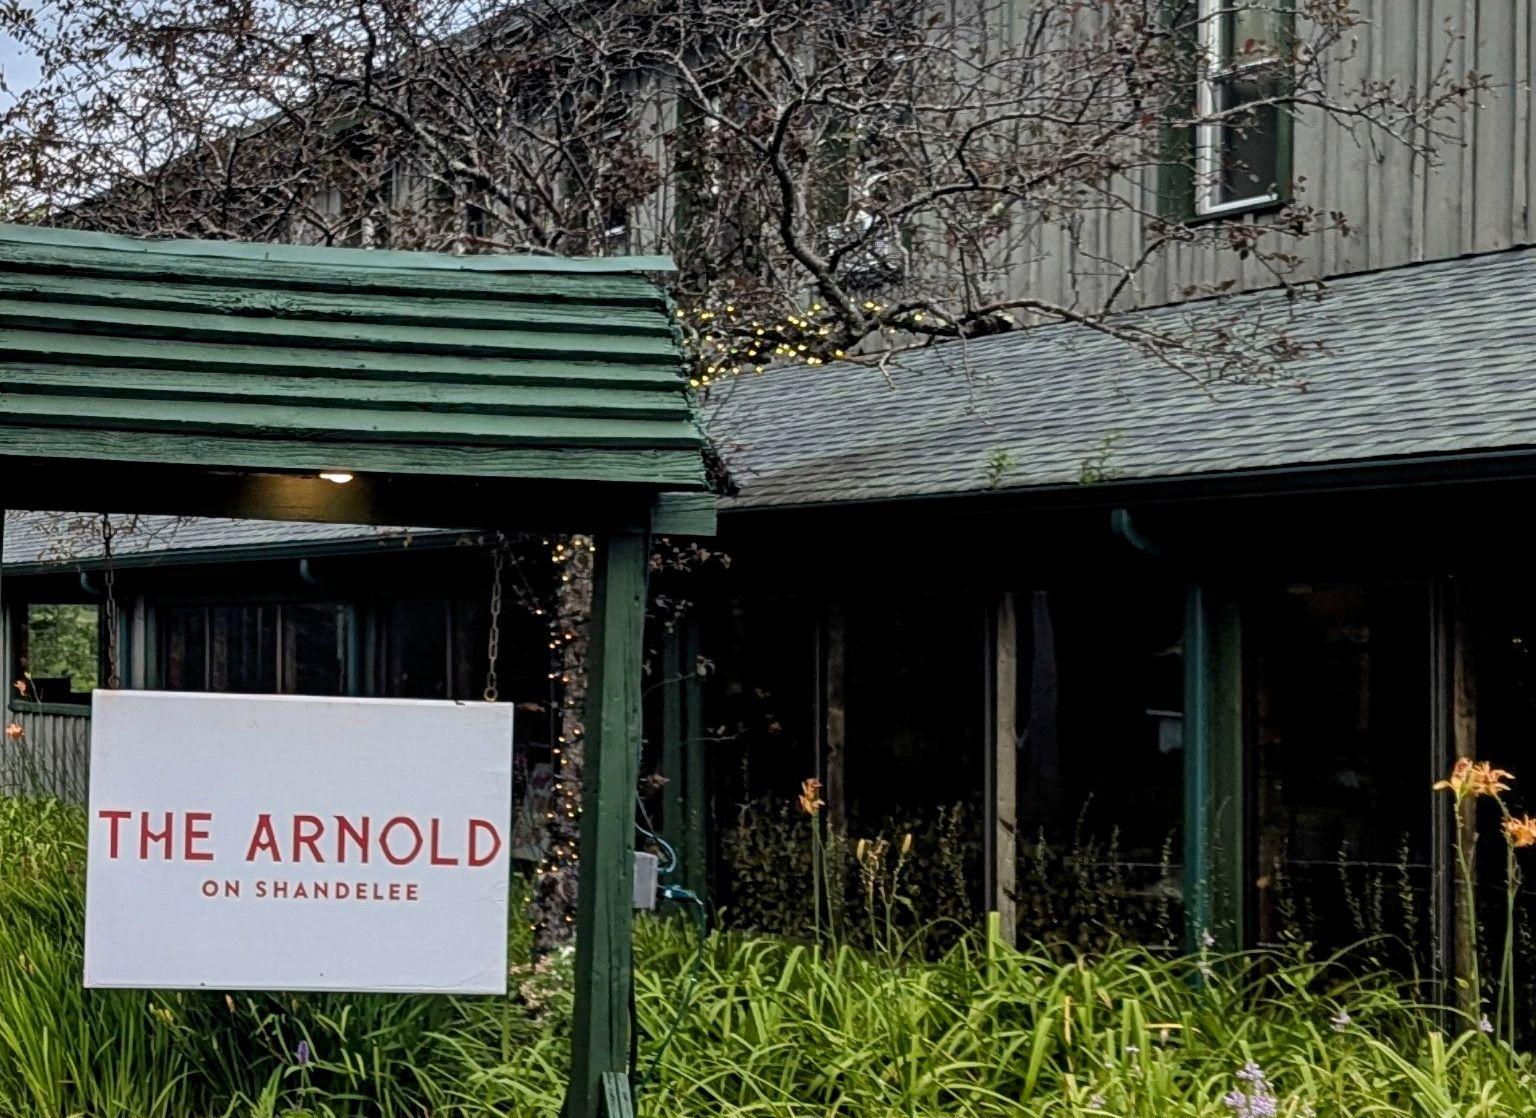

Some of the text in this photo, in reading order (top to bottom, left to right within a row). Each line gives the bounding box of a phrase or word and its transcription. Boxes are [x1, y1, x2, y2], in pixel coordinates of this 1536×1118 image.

[98, 810, 501, 867] THE ARNOLD
[201, 880, 420, 901] ON SHANDELEE
